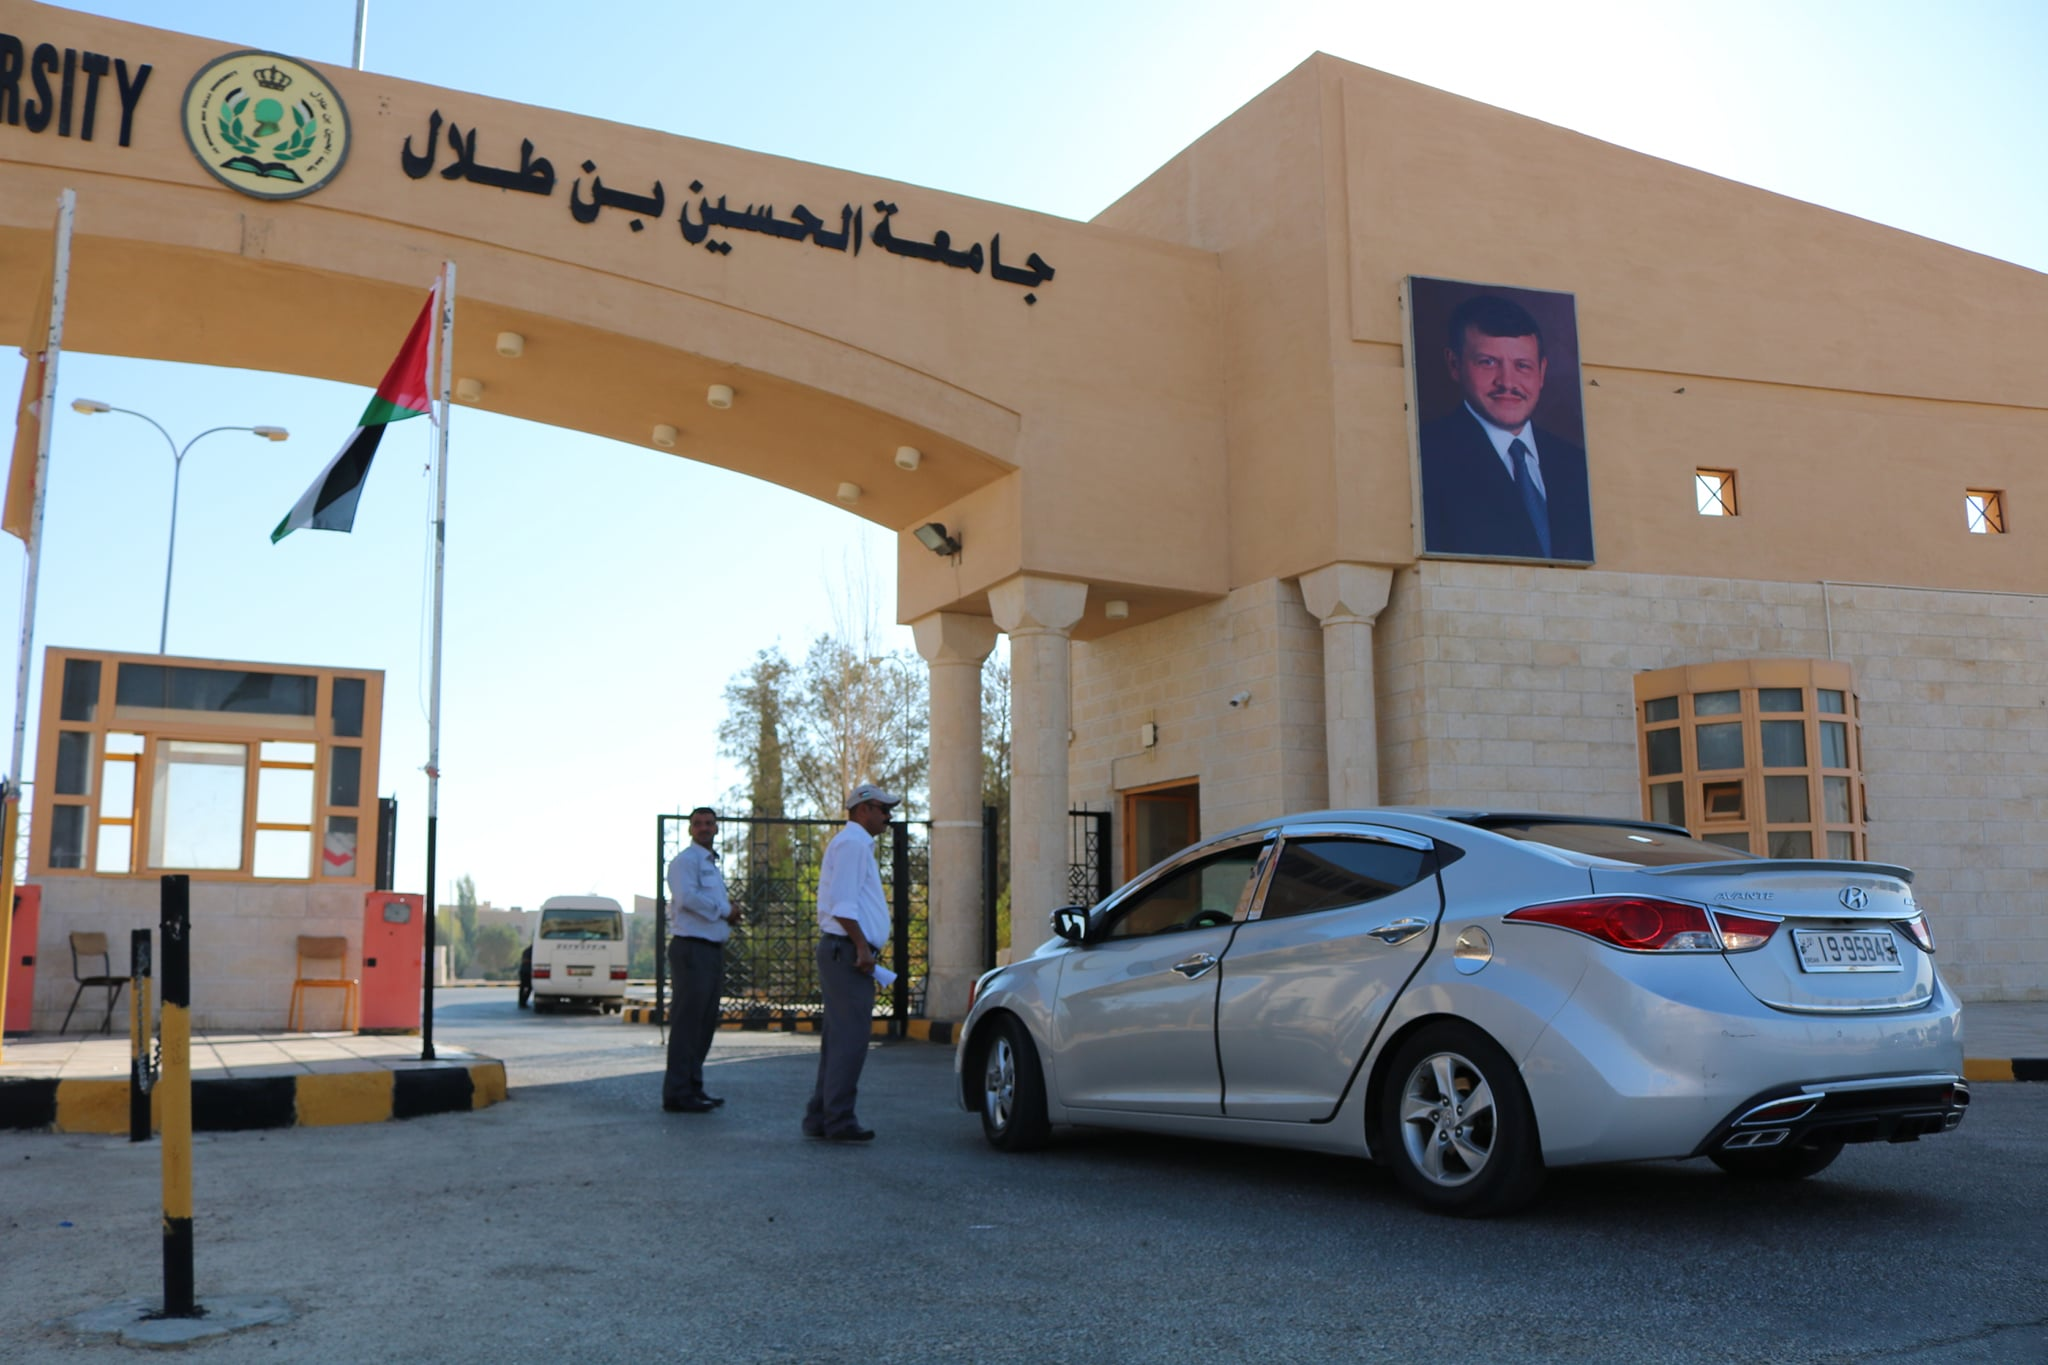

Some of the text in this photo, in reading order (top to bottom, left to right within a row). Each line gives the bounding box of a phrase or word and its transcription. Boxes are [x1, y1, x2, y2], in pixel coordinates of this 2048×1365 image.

[401, 109, 1056, 305] جامعة الحسين بن طلال
[1713, 890, 1775, 901] AVANTE
